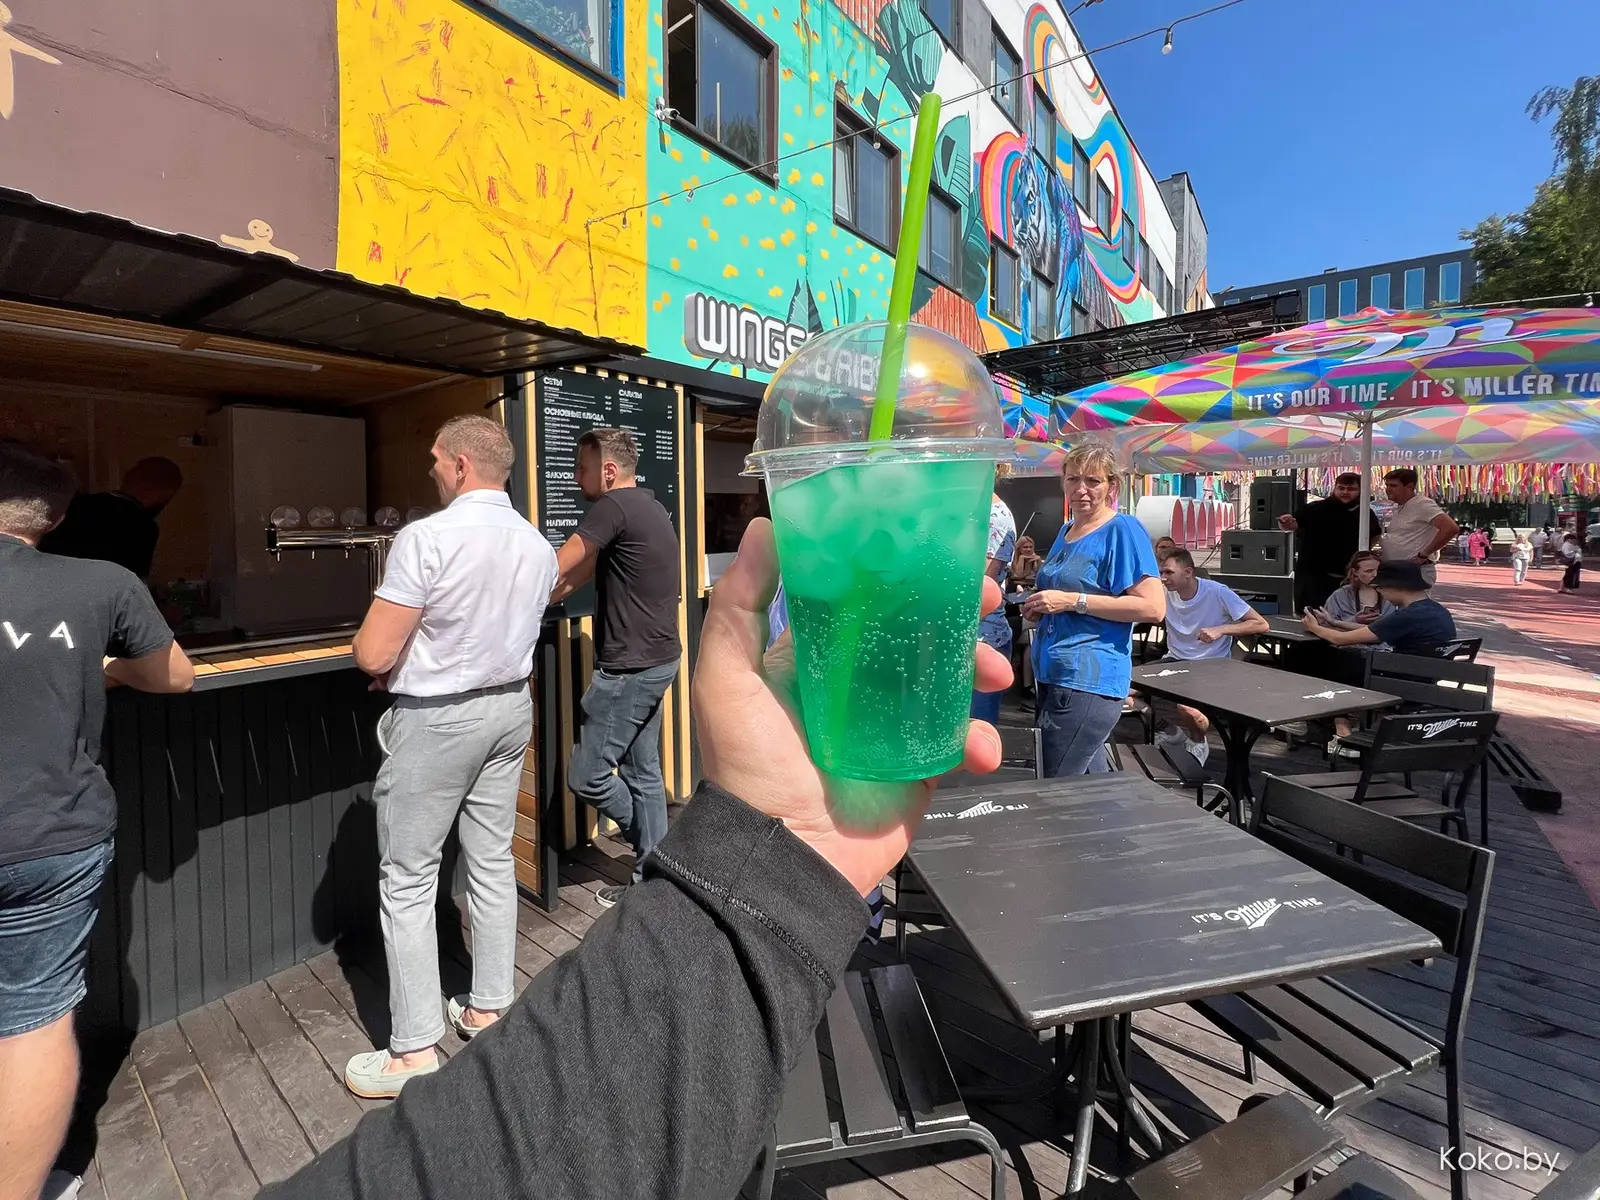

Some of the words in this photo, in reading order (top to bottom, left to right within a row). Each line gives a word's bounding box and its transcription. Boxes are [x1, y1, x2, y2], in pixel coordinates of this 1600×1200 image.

[689, 291, 809, 369] WINGS
[836, 348, 881, 392] RIB
[1248, 392, 1284, 411] IT'S
[1291, 386, 1330, 408] OUR
[1338, 382, 1395, 404] TIME.
[1411, 378, 1454, 399] IT'S
[1464, 374, 1554, 396] MILLER
[546, 519, 578, 527] НАПИТКИ
[1407, 723, 1423, 731] IT'S
[1422, 718, 1461, 739] Miller
[1459, 720, 1478, 728] TIME
[923, 812, 955, 820] TIME
[1191, 912, 1223, 924] IT'S
[1224, 897, 1282, 930] Miller
[1283, 897, 1324, 909] TIME
